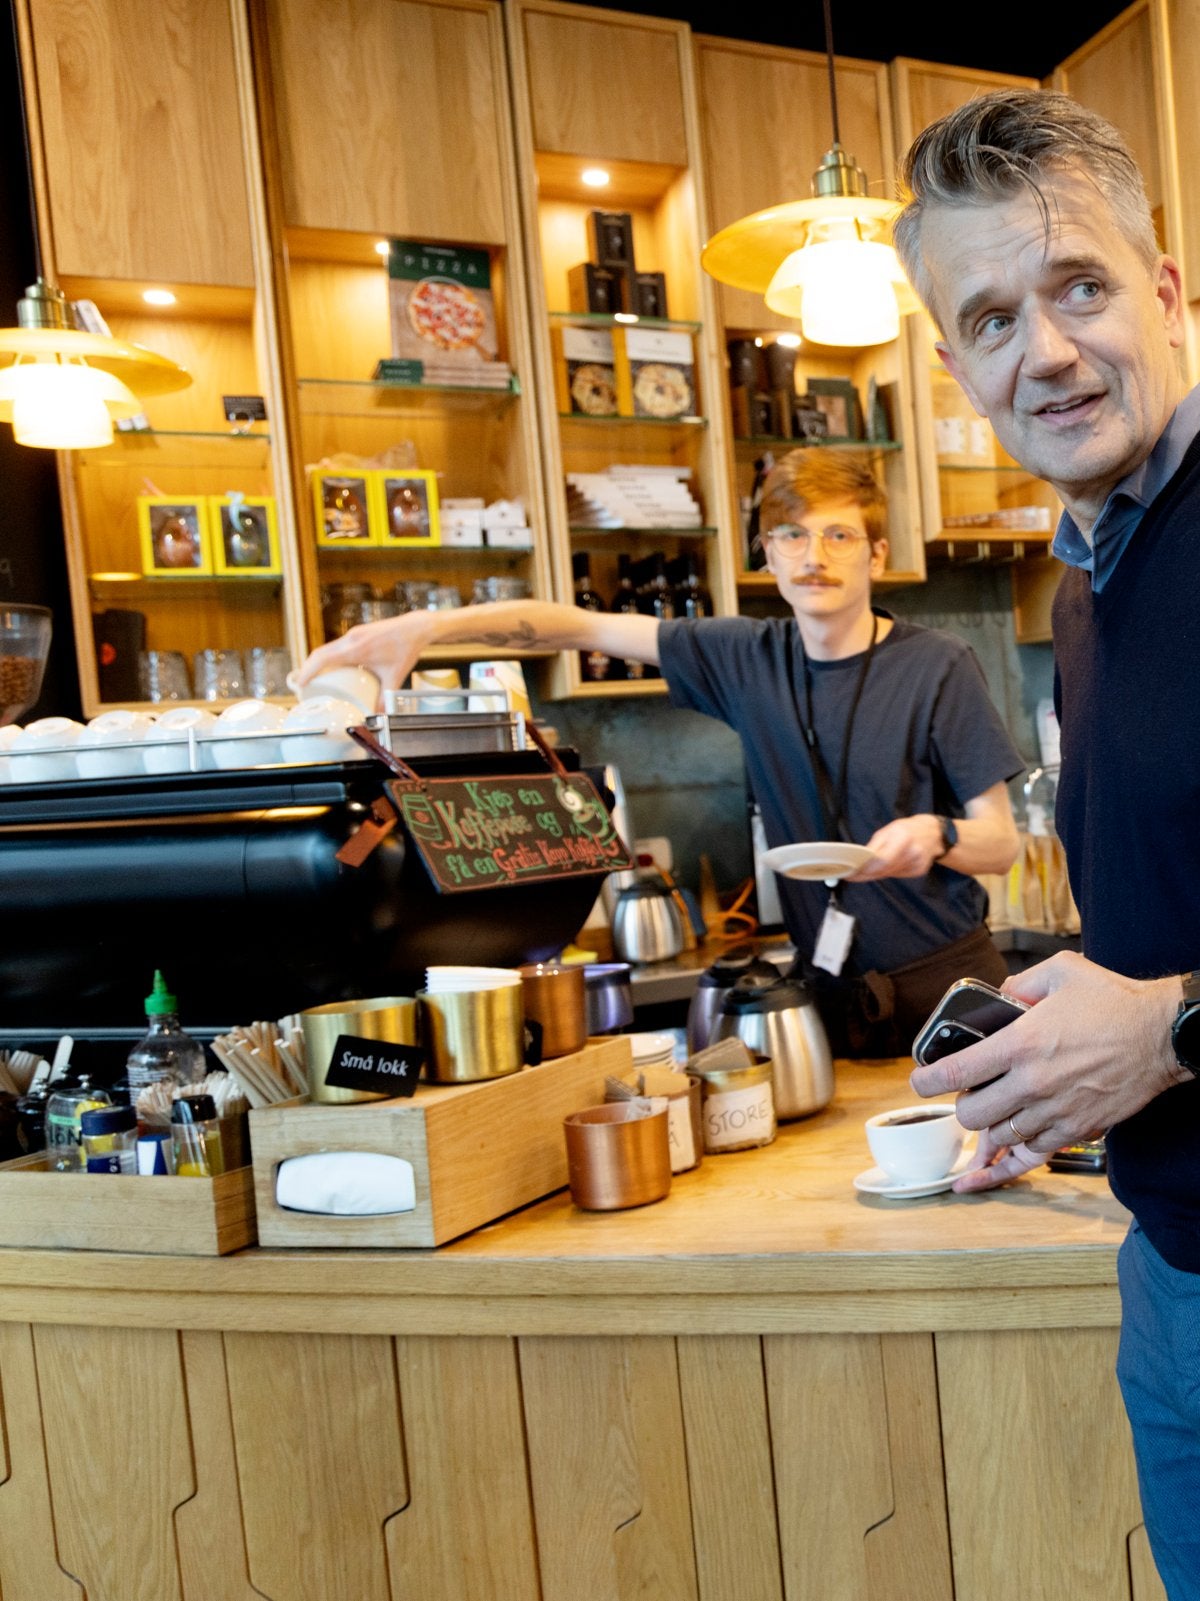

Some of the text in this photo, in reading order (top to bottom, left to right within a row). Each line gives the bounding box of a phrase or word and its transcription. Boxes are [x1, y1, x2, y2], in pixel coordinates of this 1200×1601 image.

[404, 254, 477, 274] PIZZA
[518, 788, 544, 805] en
[536, 812, 563, 837] og
[445, 854, 475, 884] få
[474, 856, 499, 875] en
[340, 1050, 409, 1077] Små lokk
[707, 1098, 770, 1136] STORE
